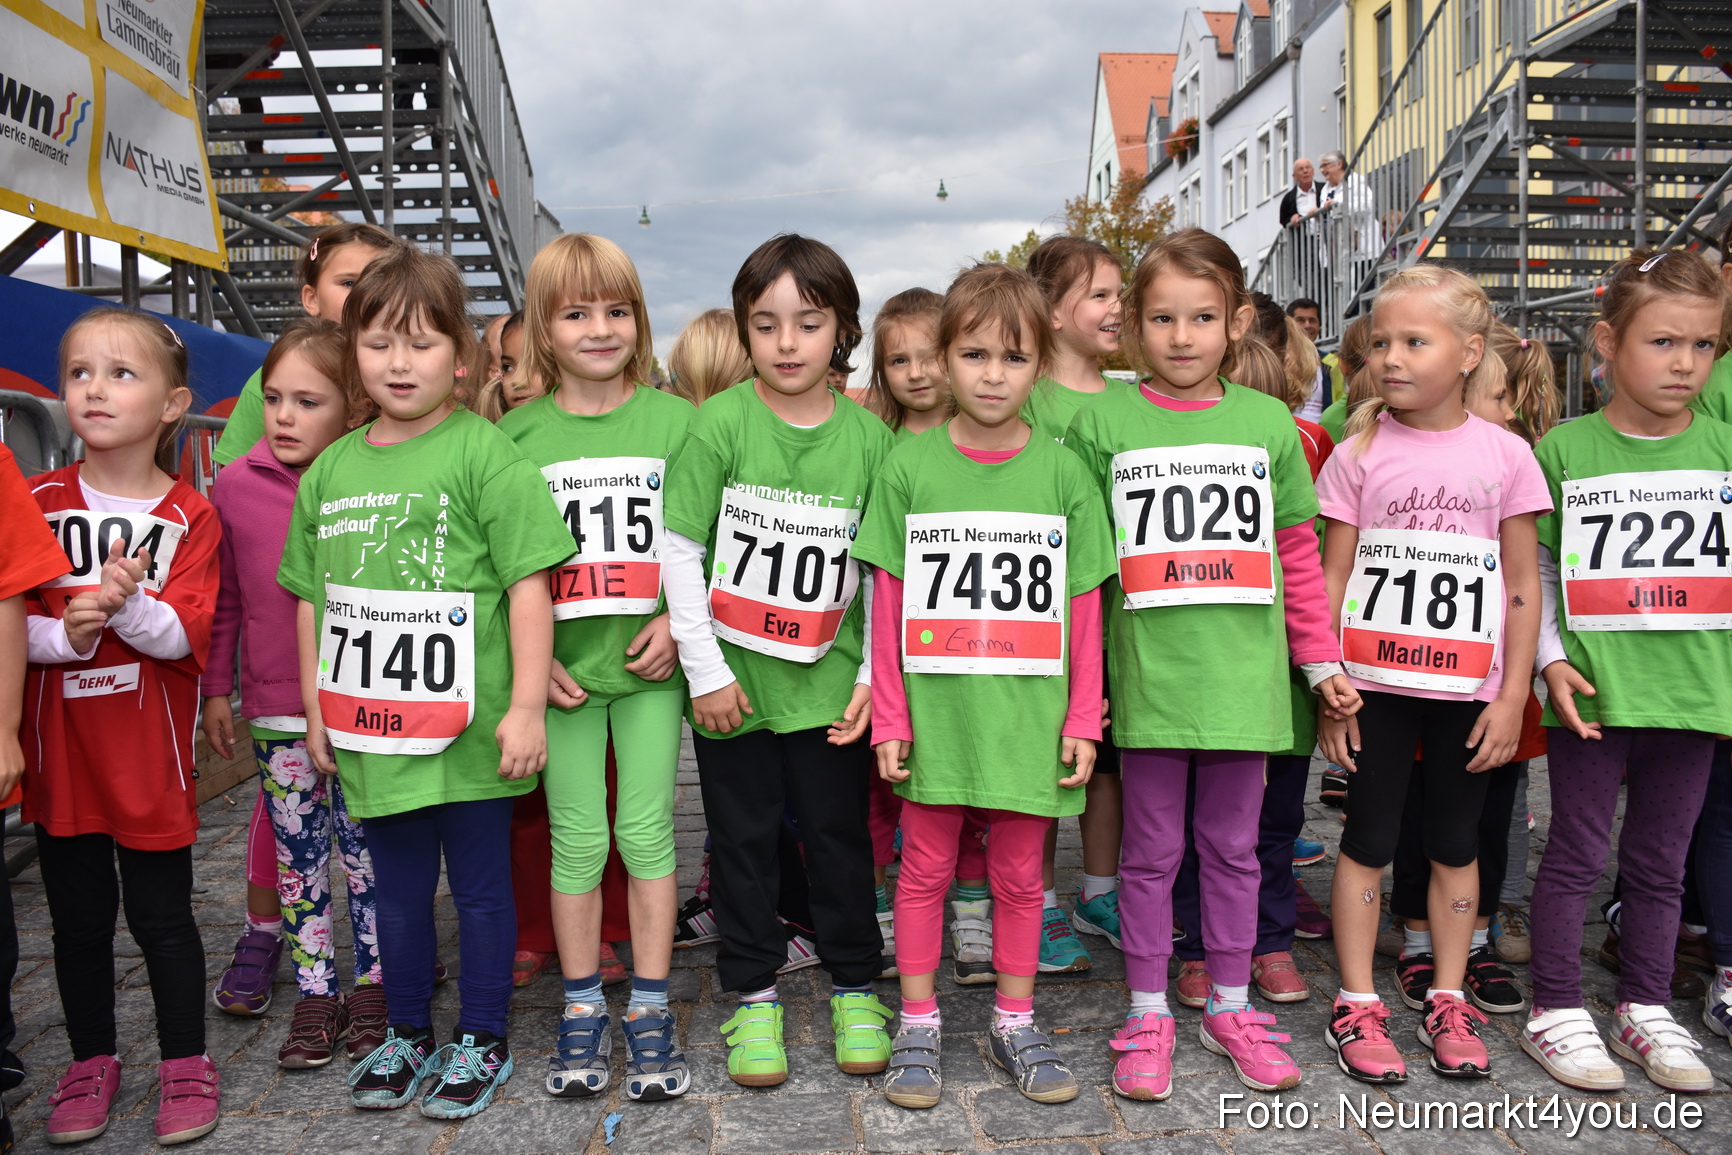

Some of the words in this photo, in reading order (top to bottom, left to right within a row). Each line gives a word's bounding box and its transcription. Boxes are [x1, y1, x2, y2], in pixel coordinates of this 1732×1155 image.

[118, 0, 173, 46] Neumarkter
[106, 3, 180, 80] Lammsbräu
[28, 134, 69, 166] neumarkt
[106, 131, 202, 193] NATHUS
[156, 184, 183, 199] MEDIA
[562, 474, 641, 491] Neumarkt
[1114, 464, 1166, 484] PARTL
[1170, 461, 1247, 477] Neumarkt
[733, 481, 823, 507] eumarkter
[1387, 485, 1471, 516] adidas
[1567, 490, 1624, 508] PARTL
[1629, 488, 1714, 503] Neumarkt
[562, 496, 654, 554] 415
[725, 504, 768, 529] PARTL
[773, 518, 846, 539] Neumarkt
[1126, 484, 1262, 546] 7029
[910, 528, 961, 545] PARTL
[964, 528, 1042, 545] Neumarkt
[1581, 511, 1731, 570] 7224
[731, 530, 850, 603] 7101
[1359, 544, 1401, 559] PARTL
[1405, 546, 1479, 567] Neumarkt
[922, 552, 1052, 612] 7438
[1164, 558, 1234, 583] Anouk
[1362, 567, 1484, 633] 7181
[1628, 585, 1688, 608] Julia
[326, 600, 357, 619] PARTL
[360, 606, 441, 624] Neumarkt
[763, 612, 801, 639] Eva
[945, 627, 1016, 655] Emma
[1377, 640, 1458, 669] Madlen
[330, 625, 455, 693] 7140
[78, 674, 117, 690] DEHN
[355, 706, 403, 735] Anja
